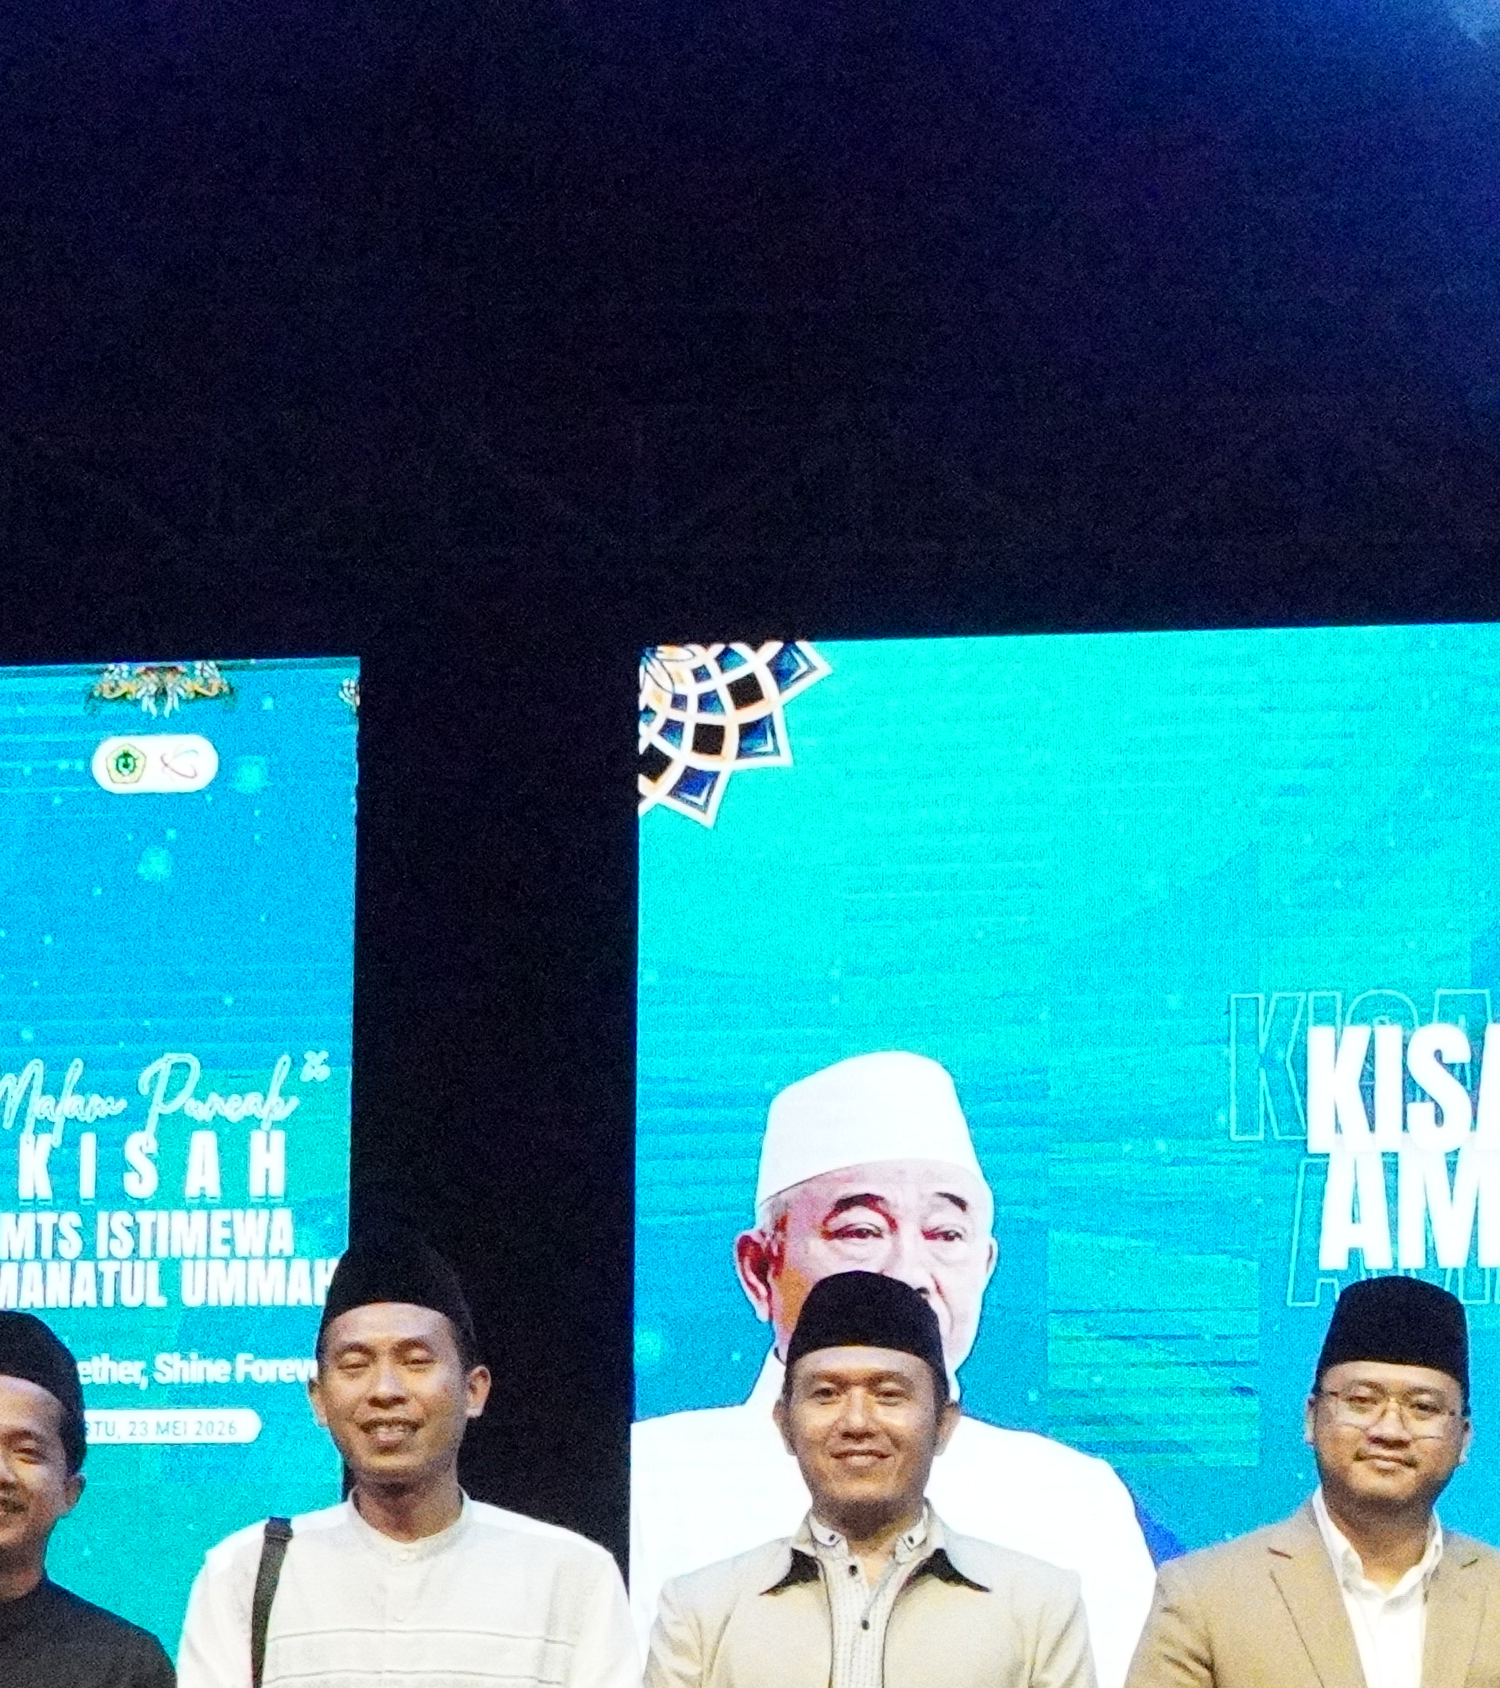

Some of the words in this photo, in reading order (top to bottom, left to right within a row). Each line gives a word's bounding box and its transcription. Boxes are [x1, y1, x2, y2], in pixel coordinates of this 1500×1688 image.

[17, 1129, 287, 1201] KISAH
[96, 1207, 295, 1259] ISTIMEWA
[76, 1352, 149, 1390] ether,
[153, 1351, 232, 1384] Shine
[234, 1352, 318, 1384] Forev
[128, 1420, 149, 1437] 23
[155, 1420, 187, 1437] MEI
[194, 1419, 238, 1437] 2026
